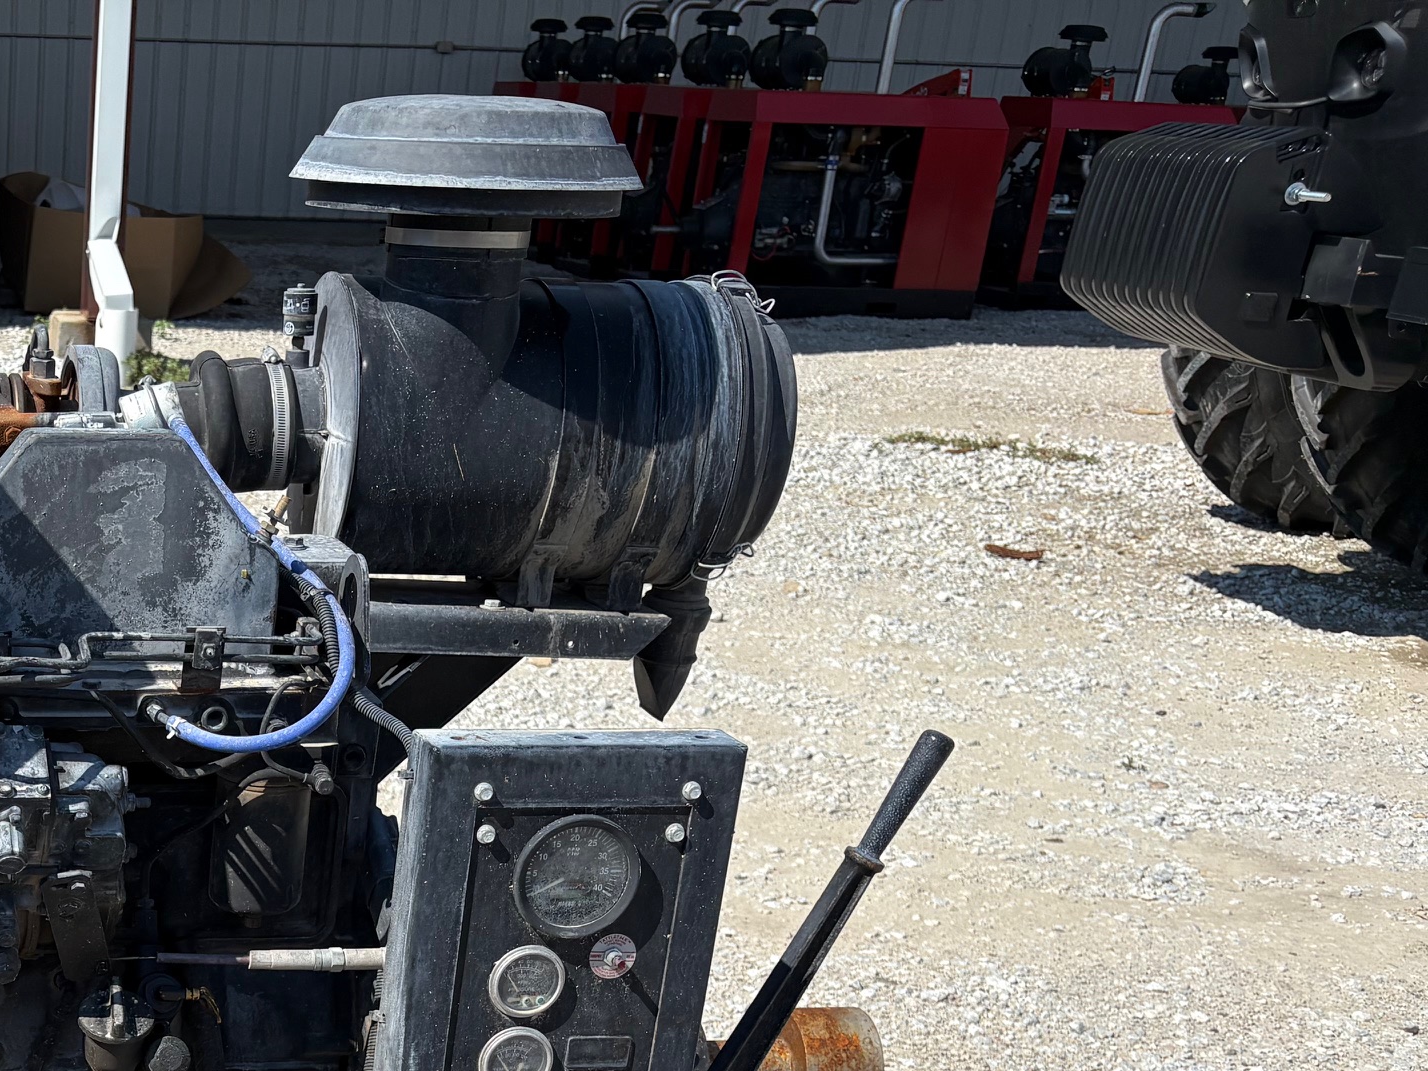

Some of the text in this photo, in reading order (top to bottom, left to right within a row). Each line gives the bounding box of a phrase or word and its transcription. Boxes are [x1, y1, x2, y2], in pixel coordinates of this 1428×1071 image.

[597, 852, 607, 860] 30
[532, 869, 538, 877] 5
[599, 867, 609, 875] 35
[592, 884, 603, 892] 40
